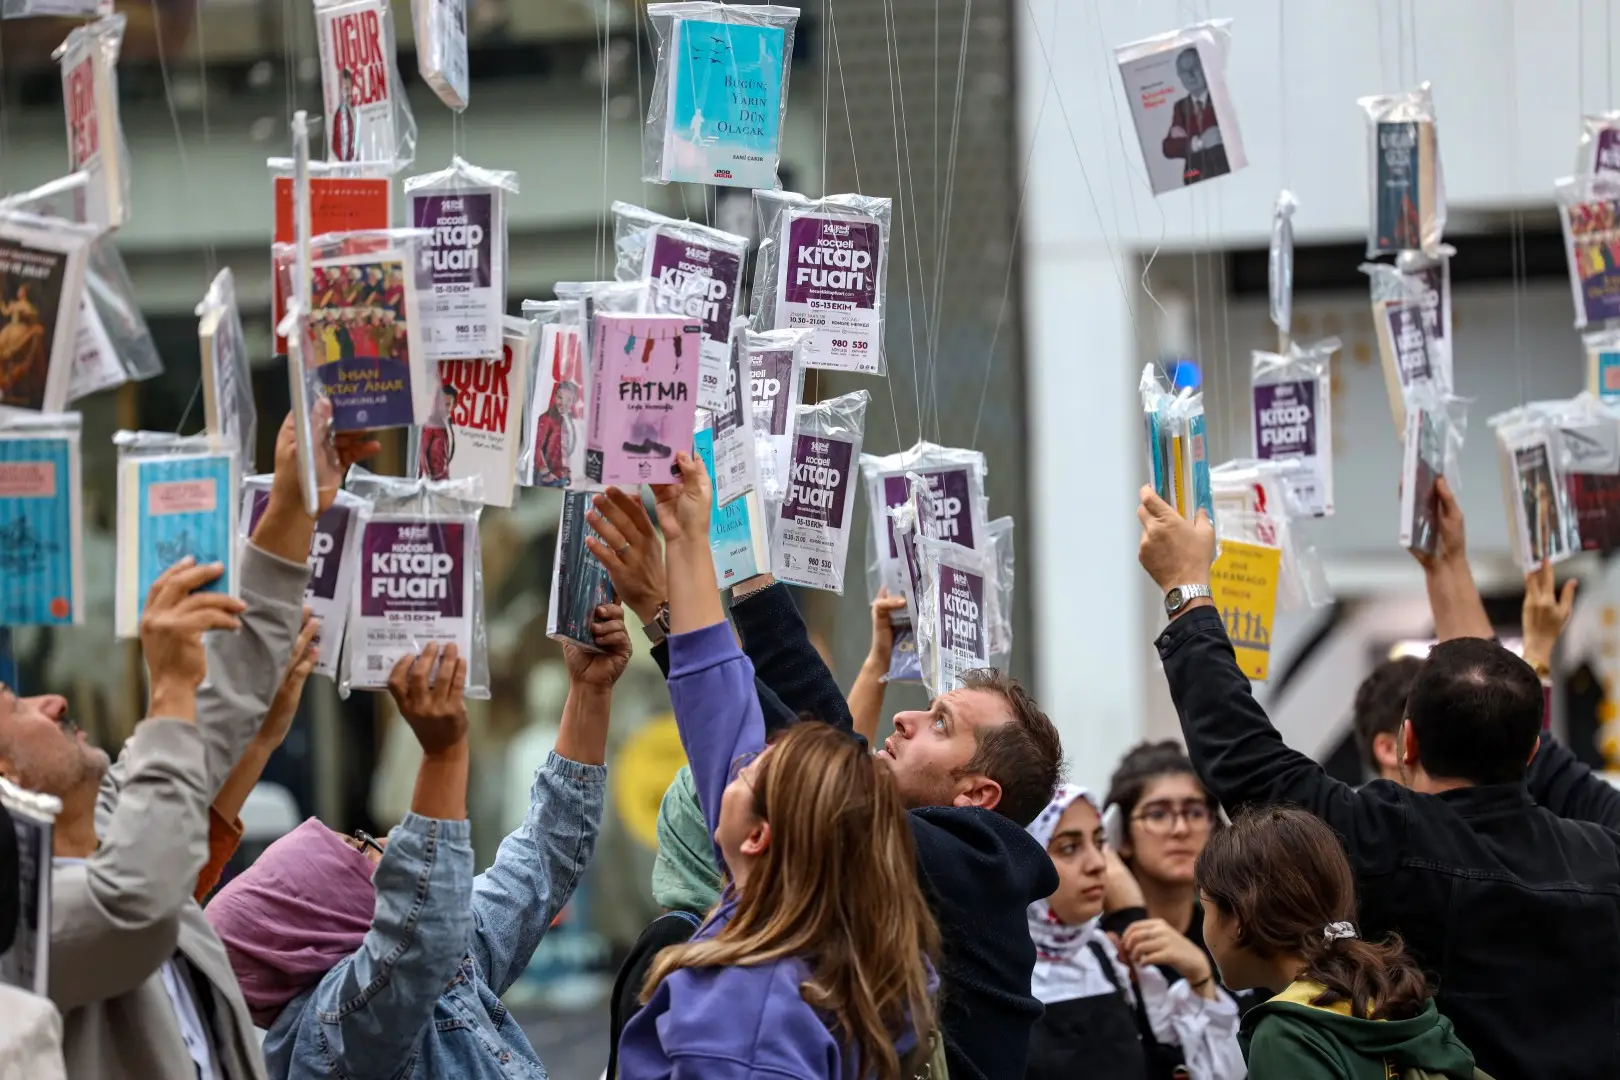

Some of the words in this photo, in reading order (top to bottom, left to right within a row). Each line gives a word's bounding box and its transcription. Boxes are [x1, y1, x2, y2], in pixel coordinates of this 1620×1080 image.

[732, 92, 766, 106] YARIN
[740, 108, 765, 123] DÜN
[717, 121, 764, 136] OLACAK
[810, 301, 831, 309] 05-13
[832, 302, 852, 311] EKİM
[831, 339, 848, 348] 980
[852, 341, 868, 350] 530
[702, 375, 718, 385] 530
[619, 381, 687, 402] FATMA
[450, 390, 509, 434] SLAN
[808, 557, 819, 566] 980
[821, 559, 832, 569] 530
